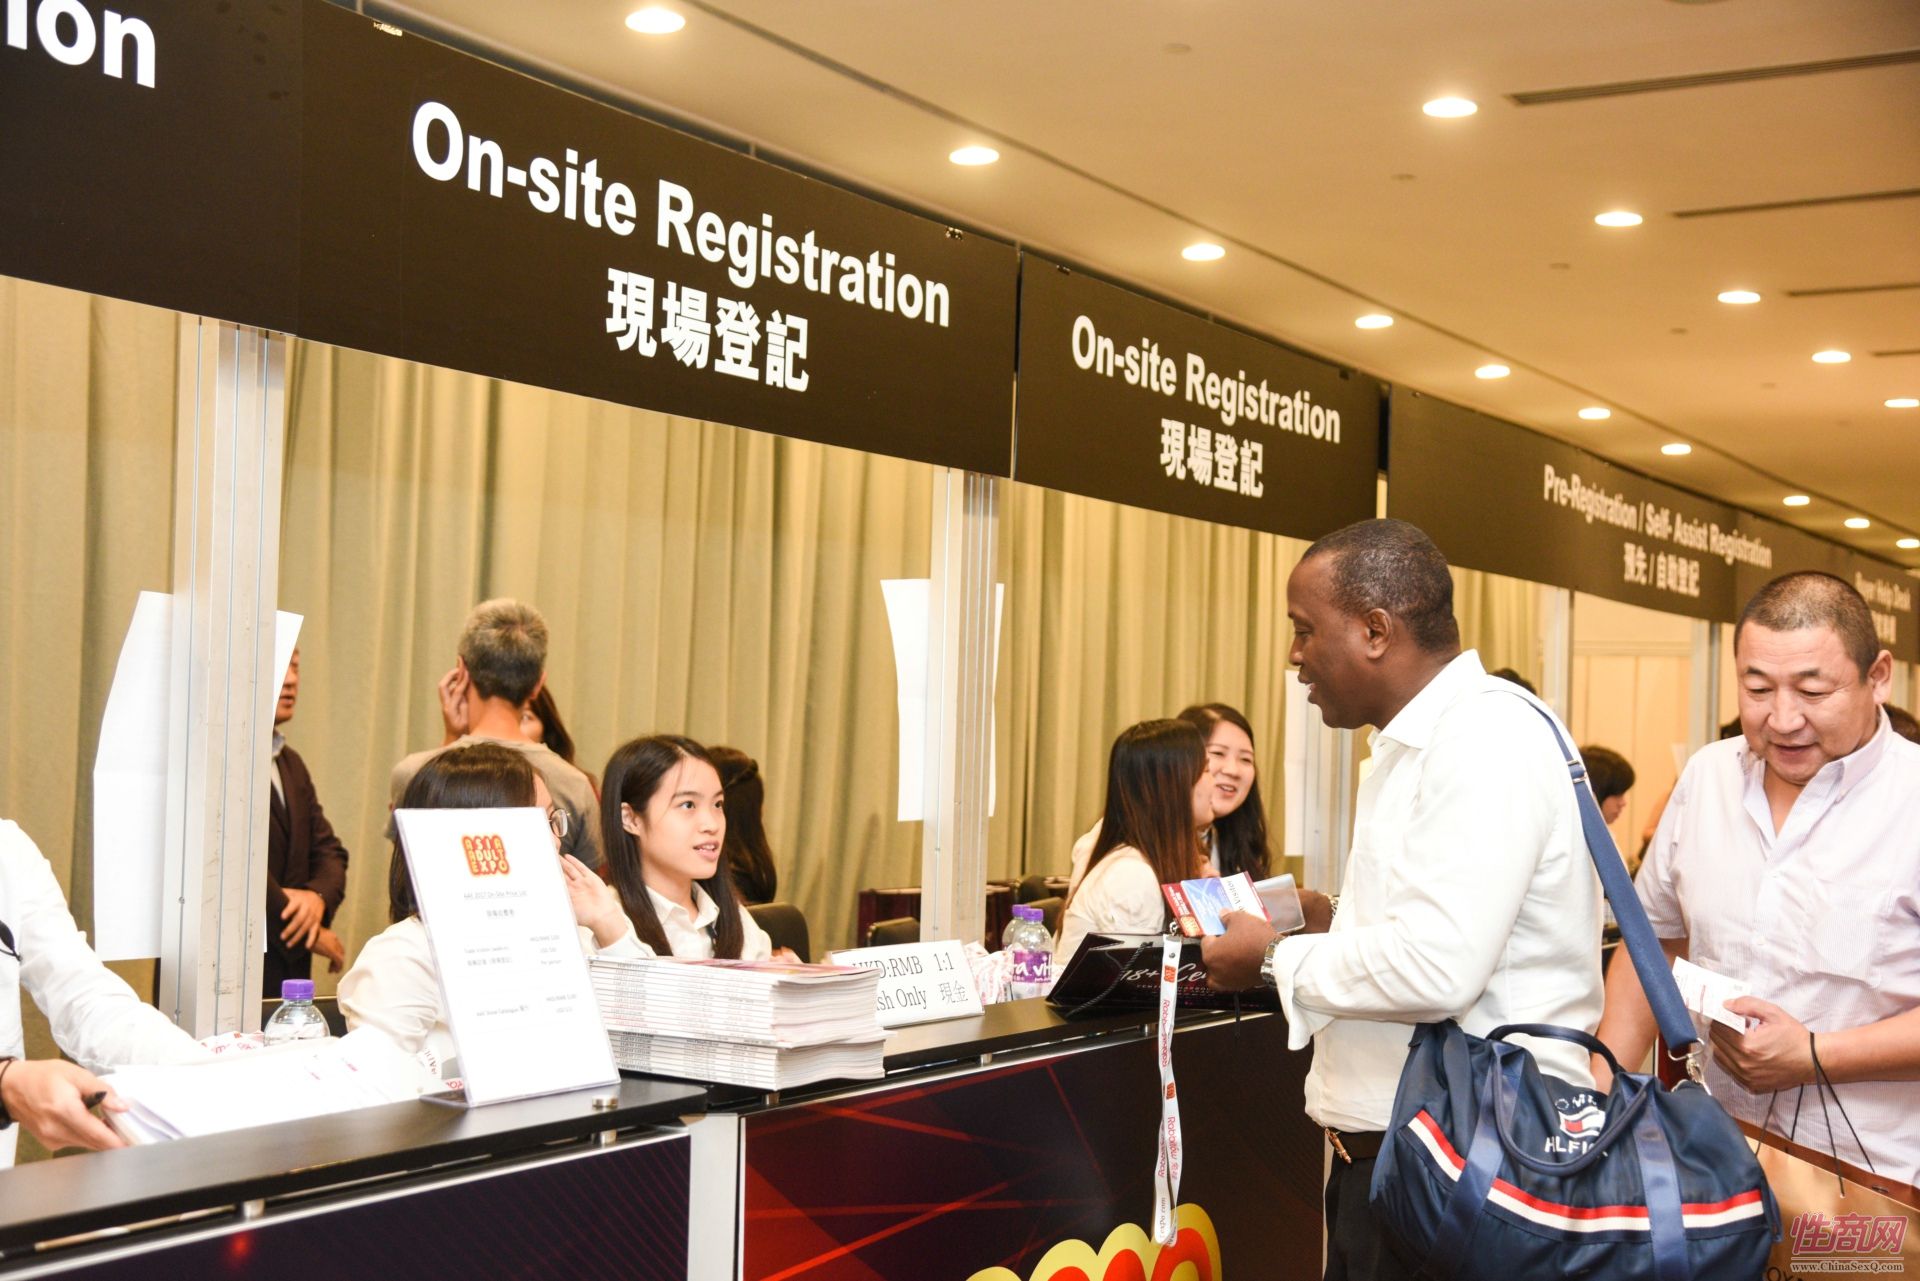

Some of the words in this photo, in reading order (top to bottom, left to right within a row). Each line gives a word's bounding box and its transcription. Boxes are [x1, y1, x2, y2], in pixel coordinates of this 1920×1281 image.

[412, 101, 637, 236] On-site
[657, 179, 950, 328] Registration
[606, 267, 810, 393] 現場登記
[1072, 314, 1177, 397] On-site
[1185, 352, 1341, 444] Registration
[1160, 418, 1264, 498] 現場登記
[1543, 464, 1638, 530] Pre-Registration
[1673, 513, 1709, 551] Assist
[1709, 523, 1773, 569] Registration
[852, 956, 923, 979] D:RMB
[933, 951, 955, 972] 1:1
[876, 990, 896, 1011] sh
[896, 986, 928, 1010] Only
[938, 980, 969, 1004] 現金
